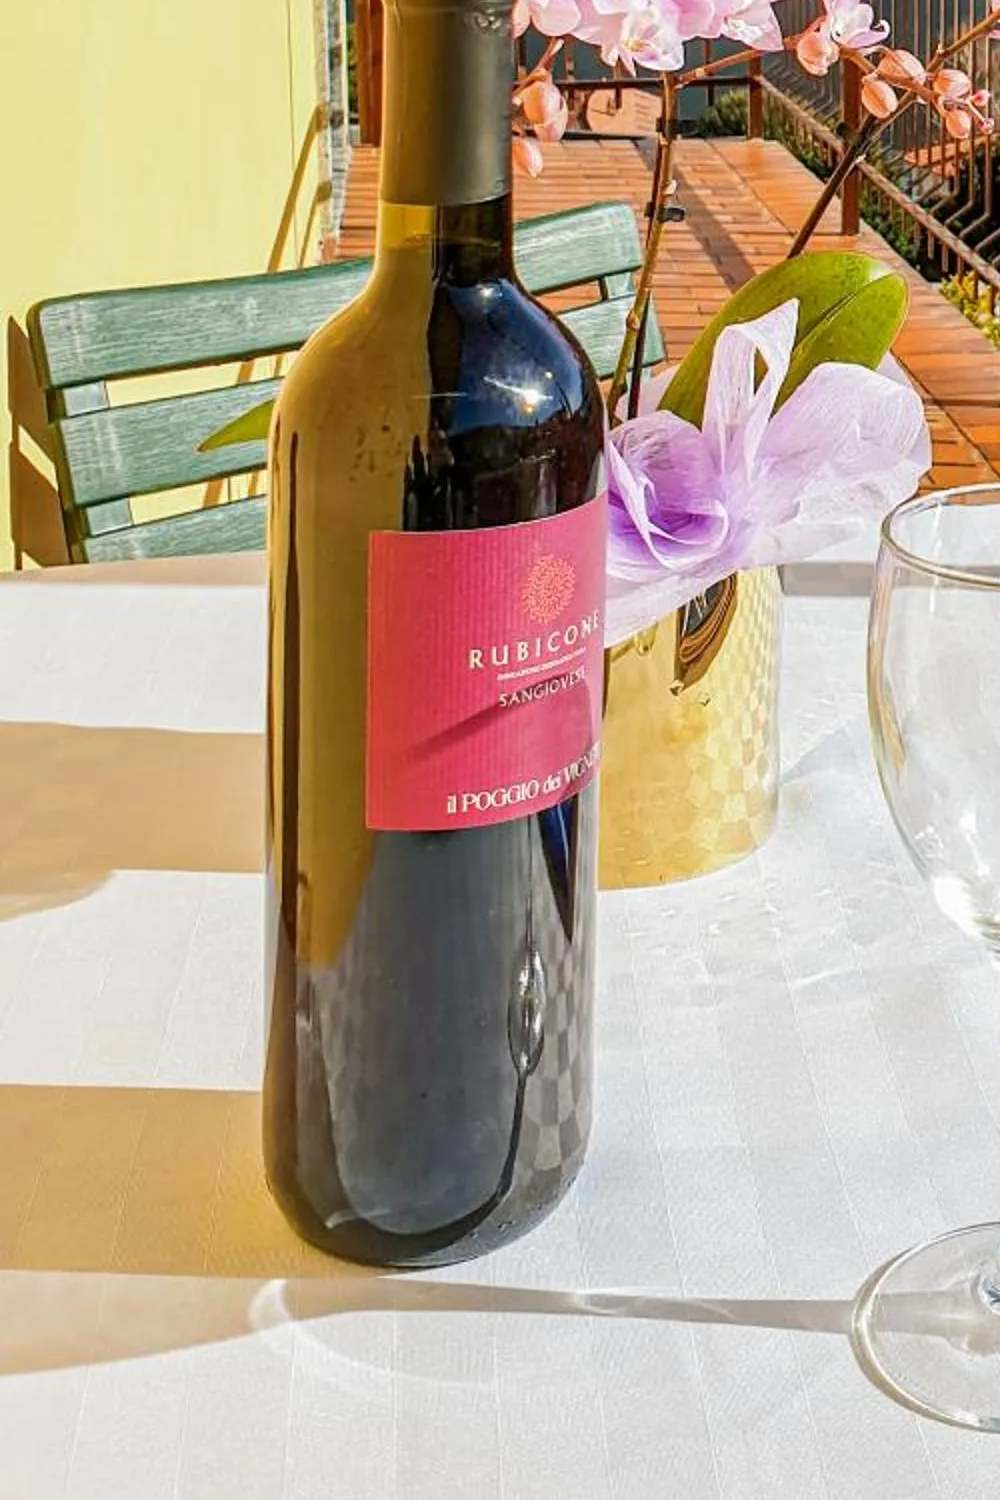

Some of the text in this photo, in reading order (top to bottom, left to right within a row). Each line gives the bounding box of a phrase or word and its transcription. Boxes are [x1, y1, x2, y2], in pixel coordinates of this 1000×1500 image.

[468, 609, 600, 669] RUBICONE
[461, 779, 540, 813] POGGIO
[543, 771, 562, 794] dei
